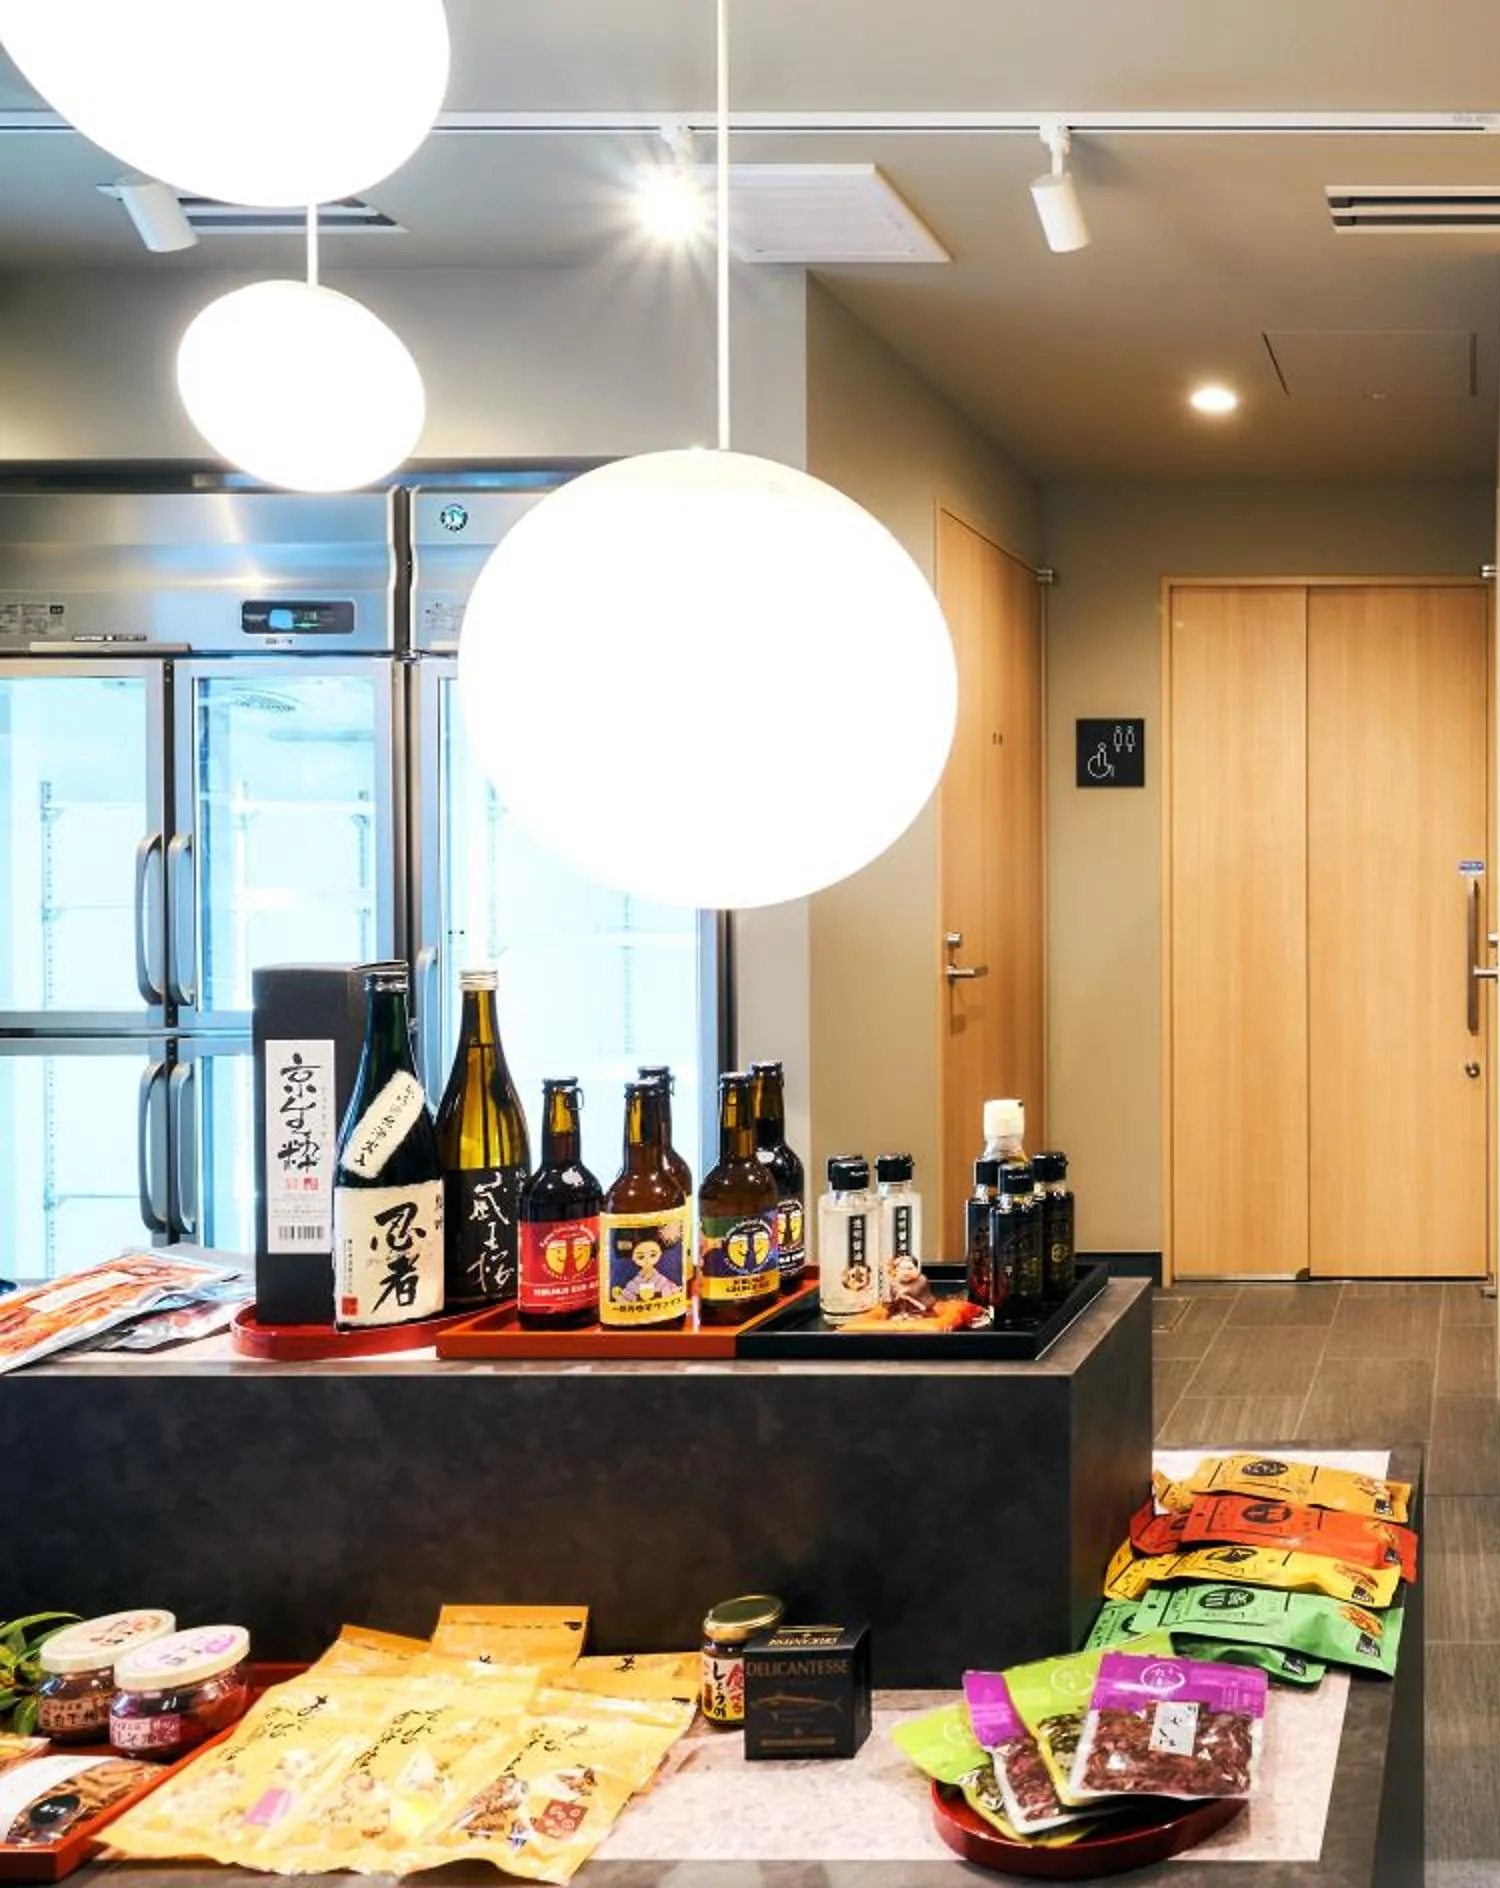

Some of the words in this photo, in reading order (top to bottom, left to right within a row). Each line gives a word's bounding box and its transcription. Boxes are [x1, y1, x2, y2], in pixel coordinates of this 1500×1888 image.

[371, 1202, 427, 1313] 忍者
[713, 1660, 727, 1718] しょうが
